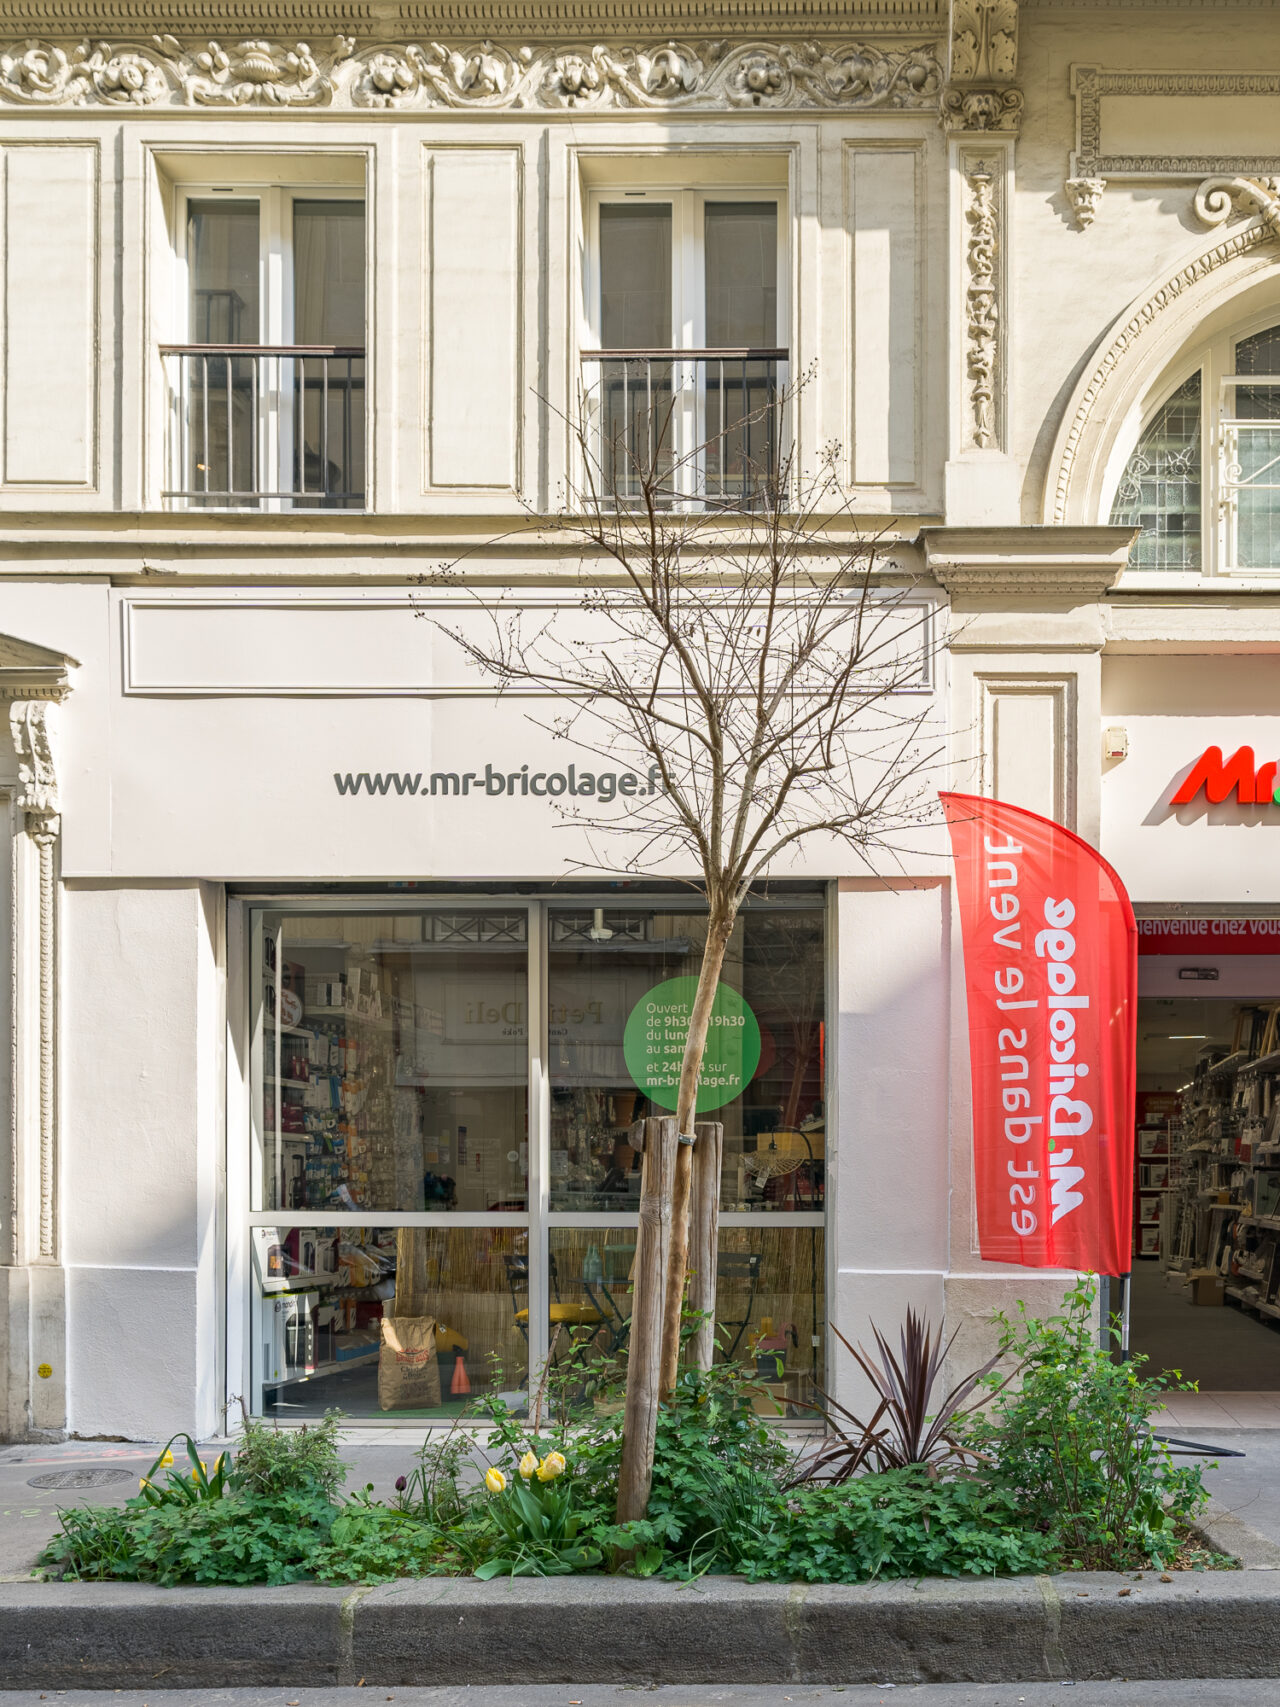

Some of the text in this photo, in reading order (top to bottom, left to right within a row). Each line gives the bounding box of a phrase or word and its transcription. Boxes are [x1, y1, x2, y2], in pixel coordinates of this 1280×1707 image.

[333, 763, 676, 802] www.mr-bricolage.fr
[1137, 919, 1208, 935] ienvenue
[1211, 919, 1247, 935] chez
[646, 1002, 688, 1014] Ouvert
[646, 1015, 661, 1027] de
[709, 1015, 746, 1027] 19h30
[646, 1029, 661, 1040] du
[646, 1042, 708, 1054] au sami
[646, 1061, 727, 1073] et 24h4 sur
[646, 1073, 740, 1087] mr-brlage.fr
